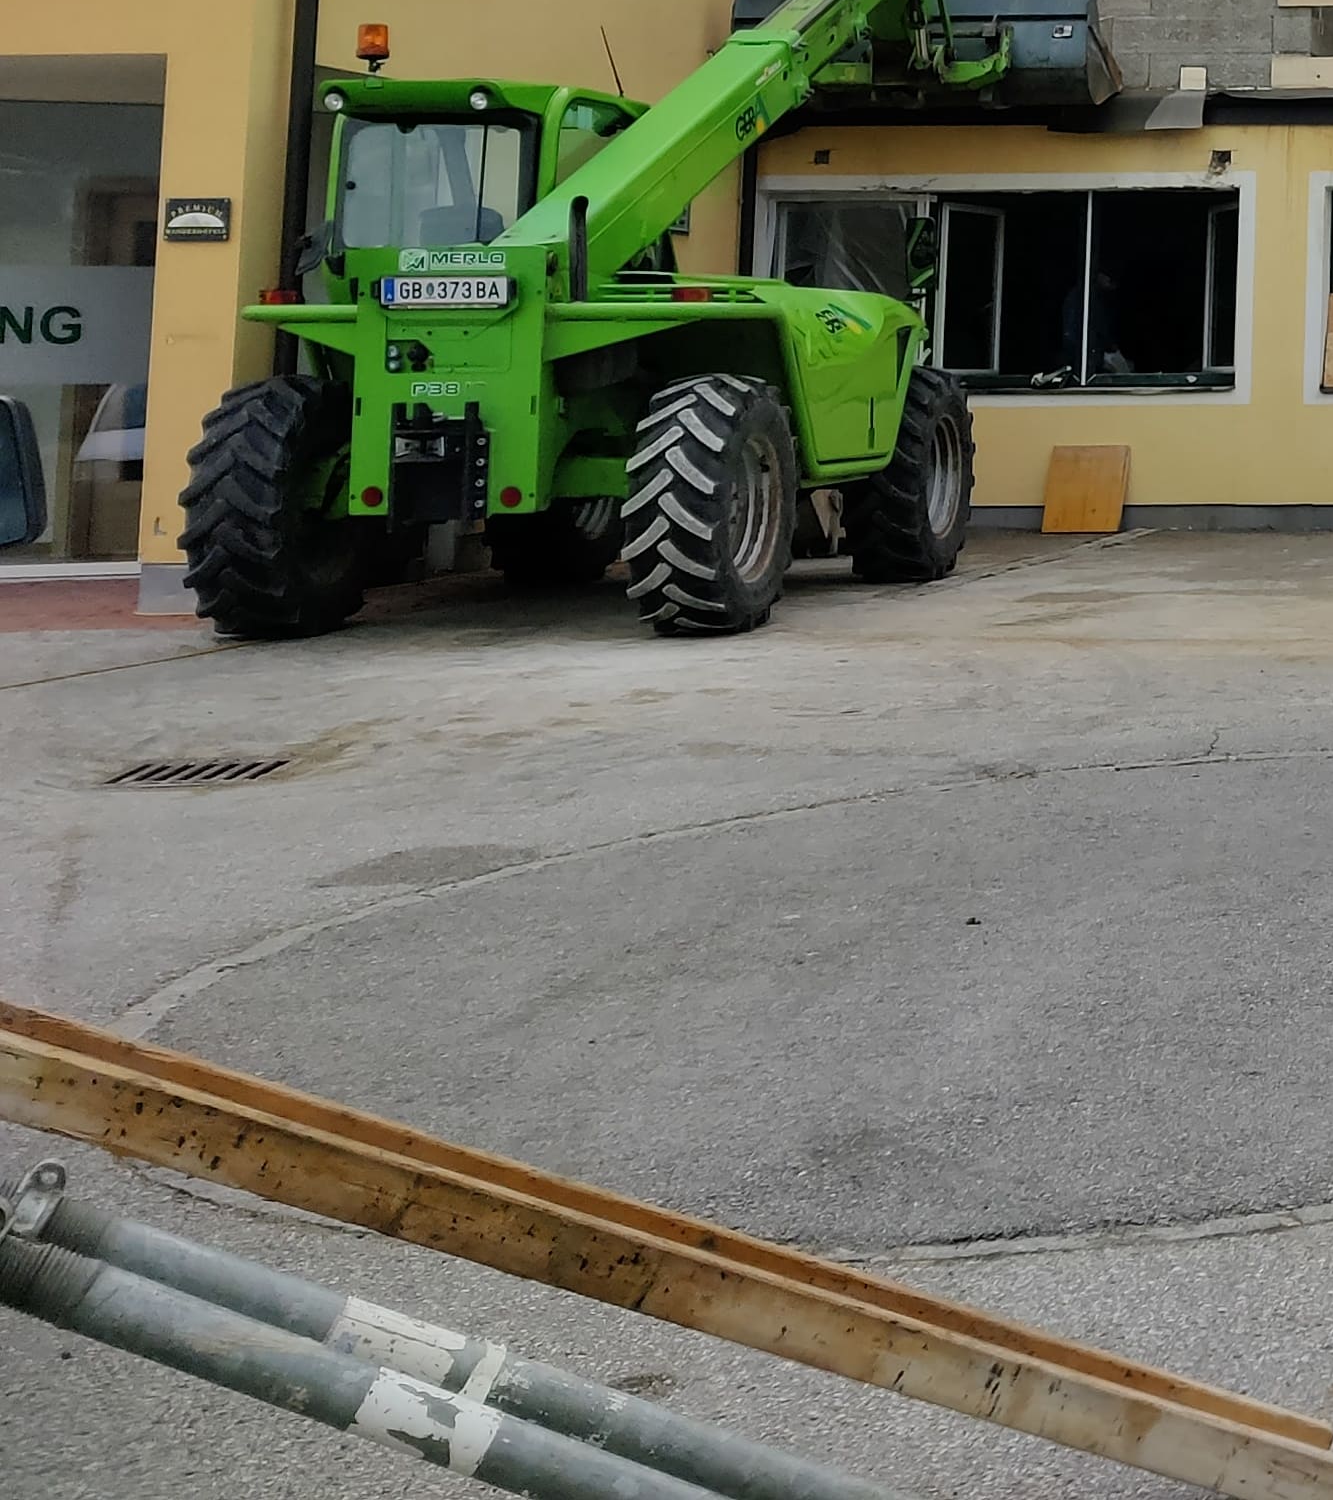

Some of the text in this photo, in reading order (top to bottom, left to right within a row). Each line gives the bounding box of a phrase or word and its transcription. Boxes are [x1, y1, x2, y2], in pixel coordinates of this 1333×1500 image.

[170, 204, 223, 218] PREMIUM
[431, 251, 505, 266] MERLO
[399, 281, 422, 300] GB
[0, 306, 82, 345] NG
[411, 382, 460, 396] P38
